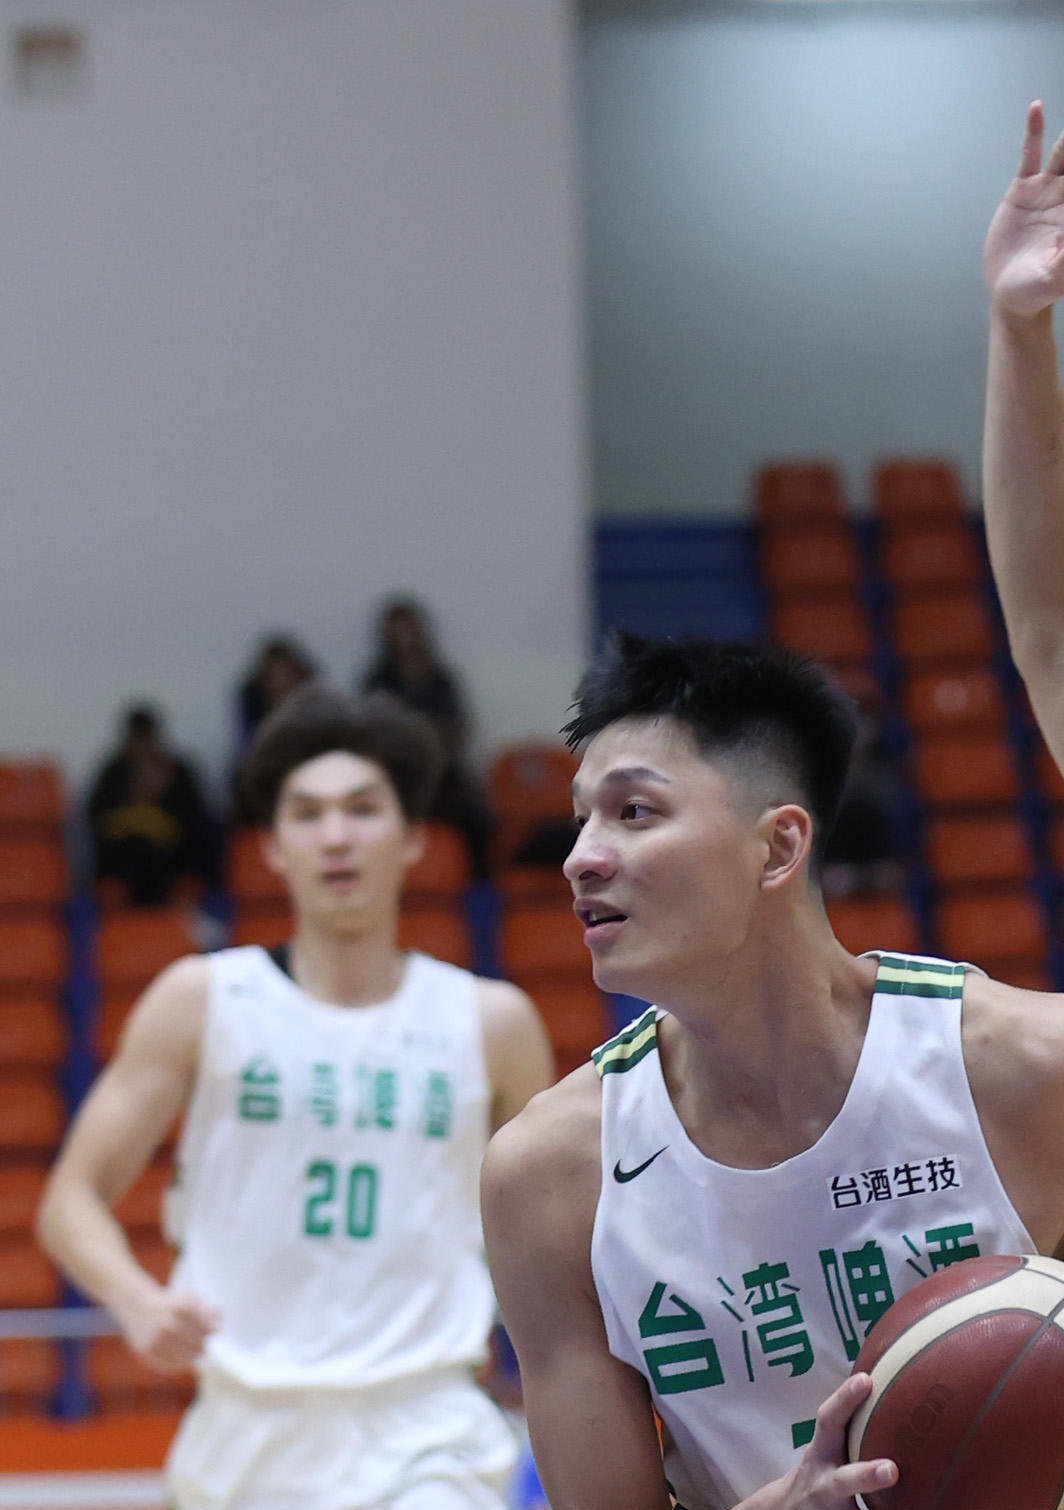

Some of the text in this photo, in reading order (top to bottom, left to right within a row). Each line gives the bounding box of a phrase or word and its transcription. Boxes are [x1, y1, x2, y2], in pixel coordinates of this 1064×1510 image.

[304, 1160, 378, 1239] 20
[831, 1157, 960, 1208] 台酒生技
